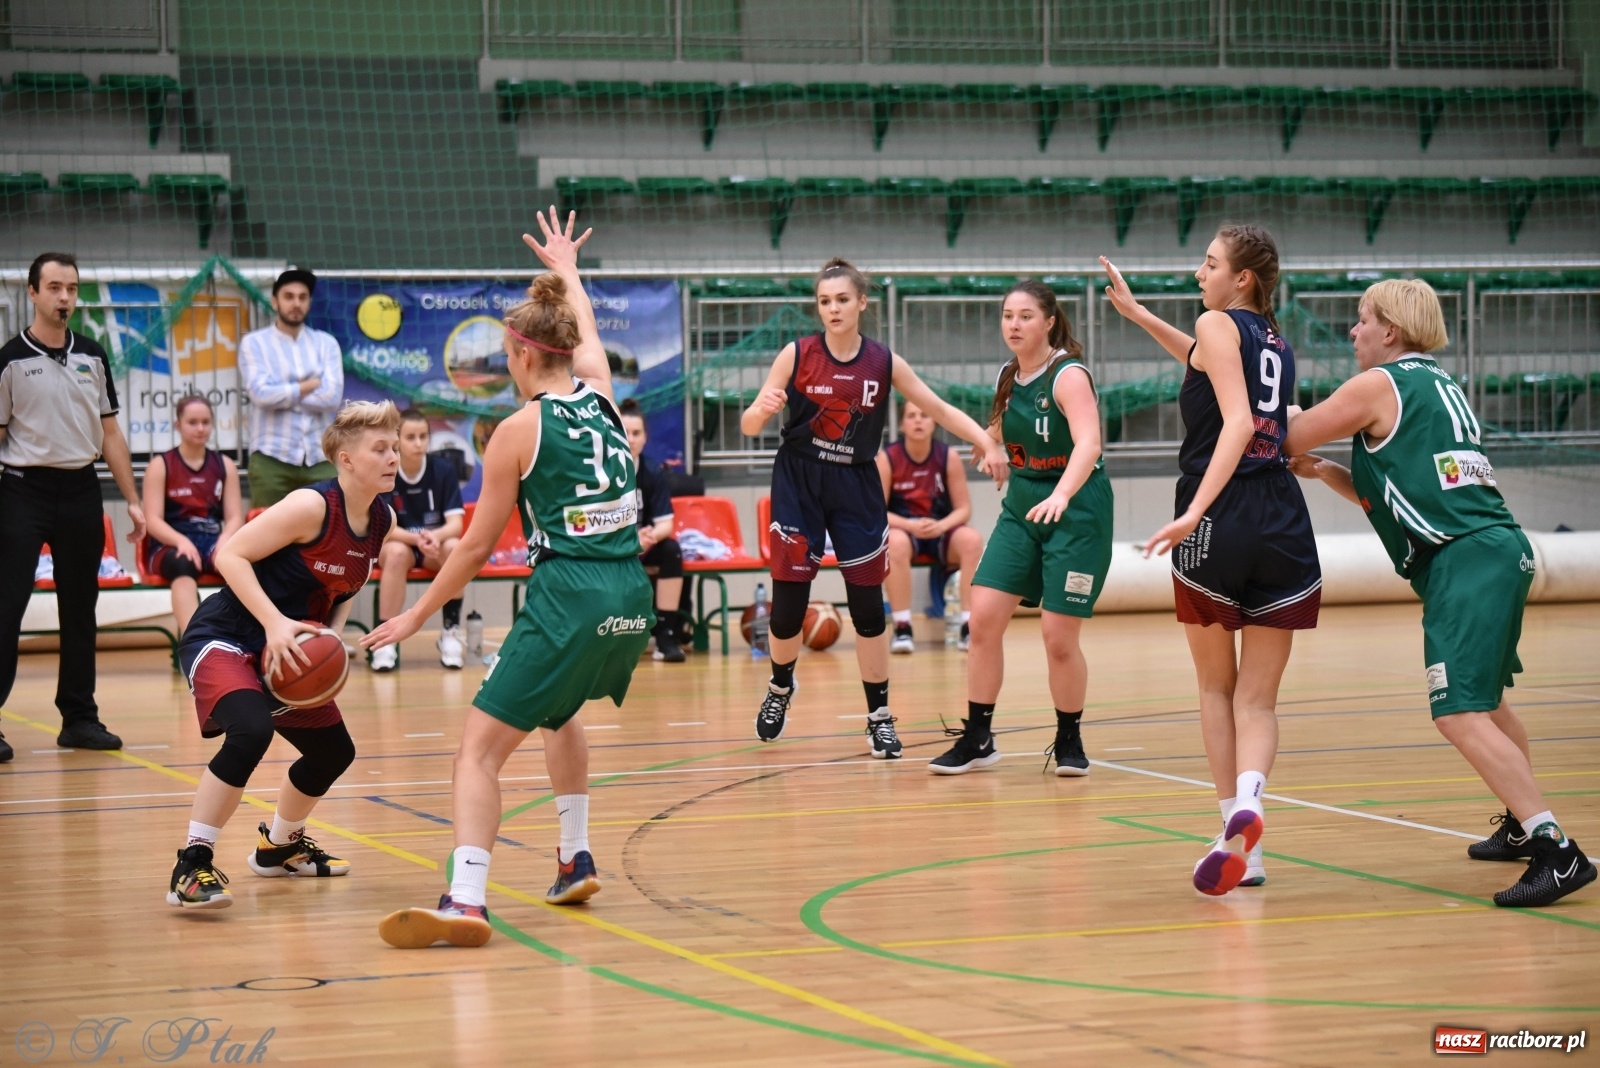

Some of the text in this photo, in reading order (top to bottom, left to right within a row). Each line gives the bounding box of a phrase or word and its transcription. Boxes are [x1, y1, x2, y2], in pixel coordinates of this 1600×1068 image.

[421, 292, 488, 310] Ośrodek
[862, 379, 879, 407] 12
[1257, 348, 1282, 412] 9
[1435, 379, 1481, 446] 10
[1035, 416, 1050, 443] 4
[568, 426, 628, 498] 35
[1203, 523, 1212, 552] PASSION
[314, 560, 327, 572] UKS
[612, 614, 647, 632] Clavis
